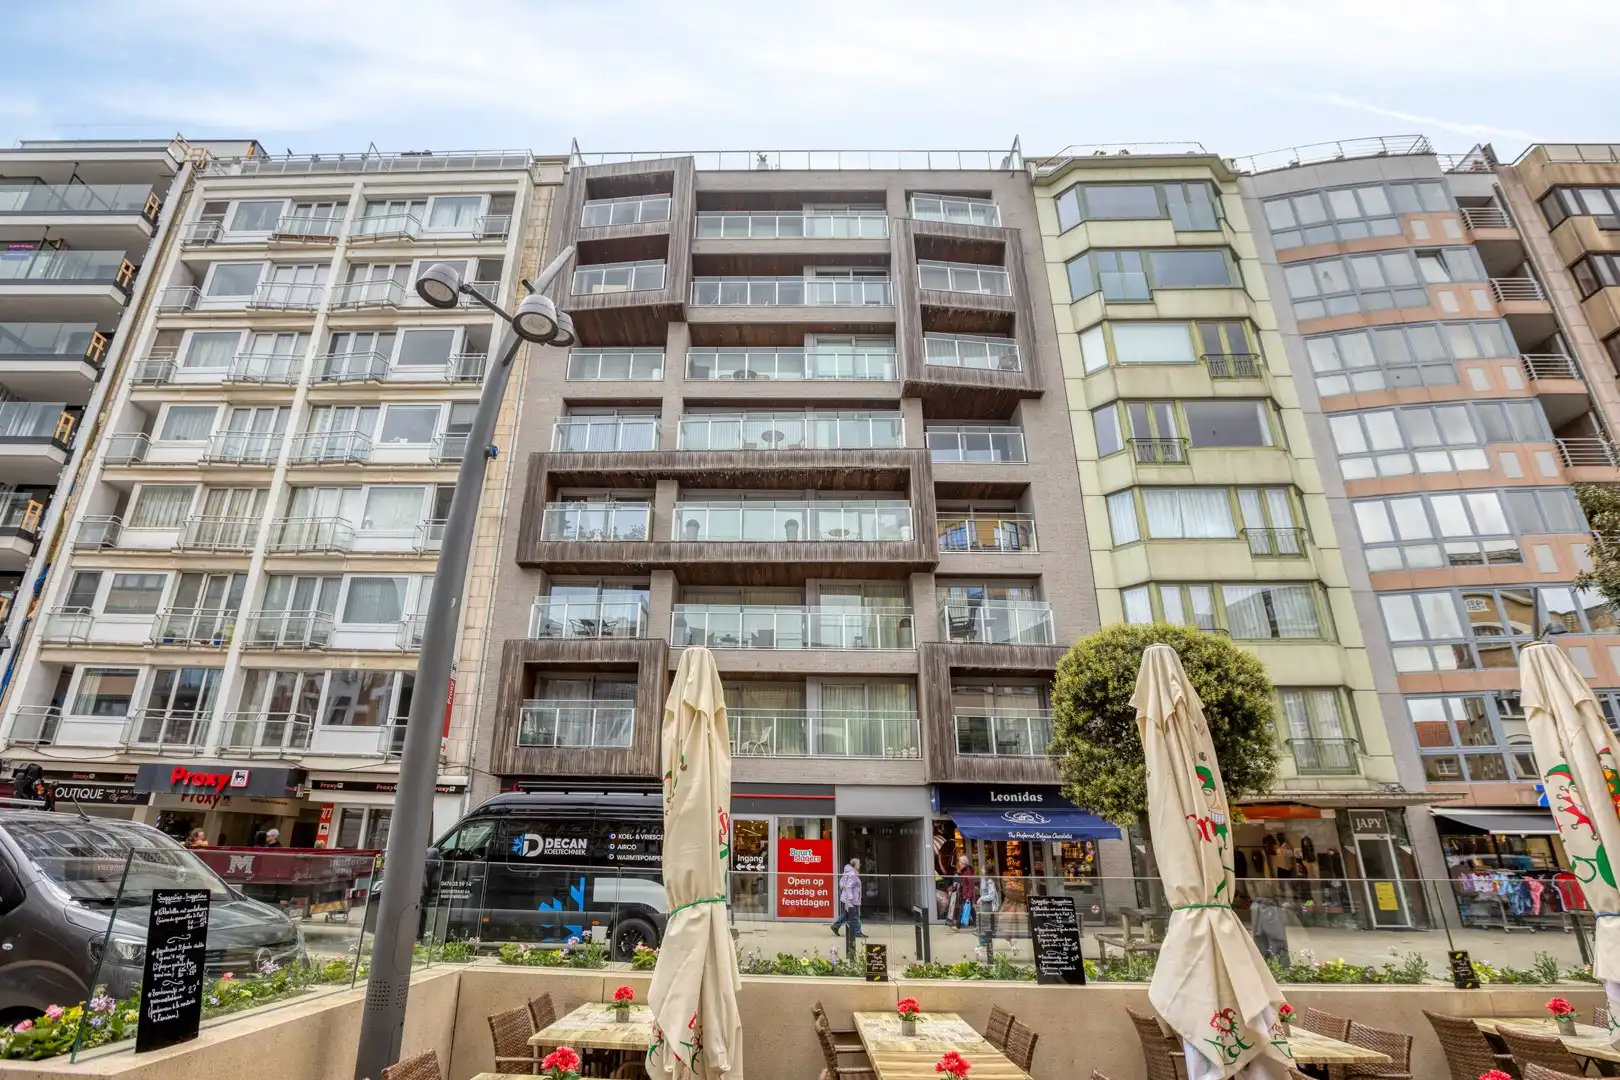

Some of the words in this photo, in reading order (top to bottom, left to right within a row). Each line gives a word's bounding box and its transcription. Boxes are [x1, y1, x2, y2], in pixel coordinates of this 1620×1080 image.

[170, 766, 231, 792] Proxy
[319, 781, 338, 789] Proxy
[990, 791, 1043, 802] Leonidas
[1355, 818, 1381, 831] JAPY
[544, 838, 588, 849] DECAN
[543, 848, 586, 856] KOELTECHNIEK
[790, 848, 812, 857] Buurt
[737, 854, 764, 864] Ingang
[787, 876, 811, 887] Open
[813, 879, 824, 887] op
[783, 888, 815, 898] zondag
[782, 898, 830, 908] feestdagen
